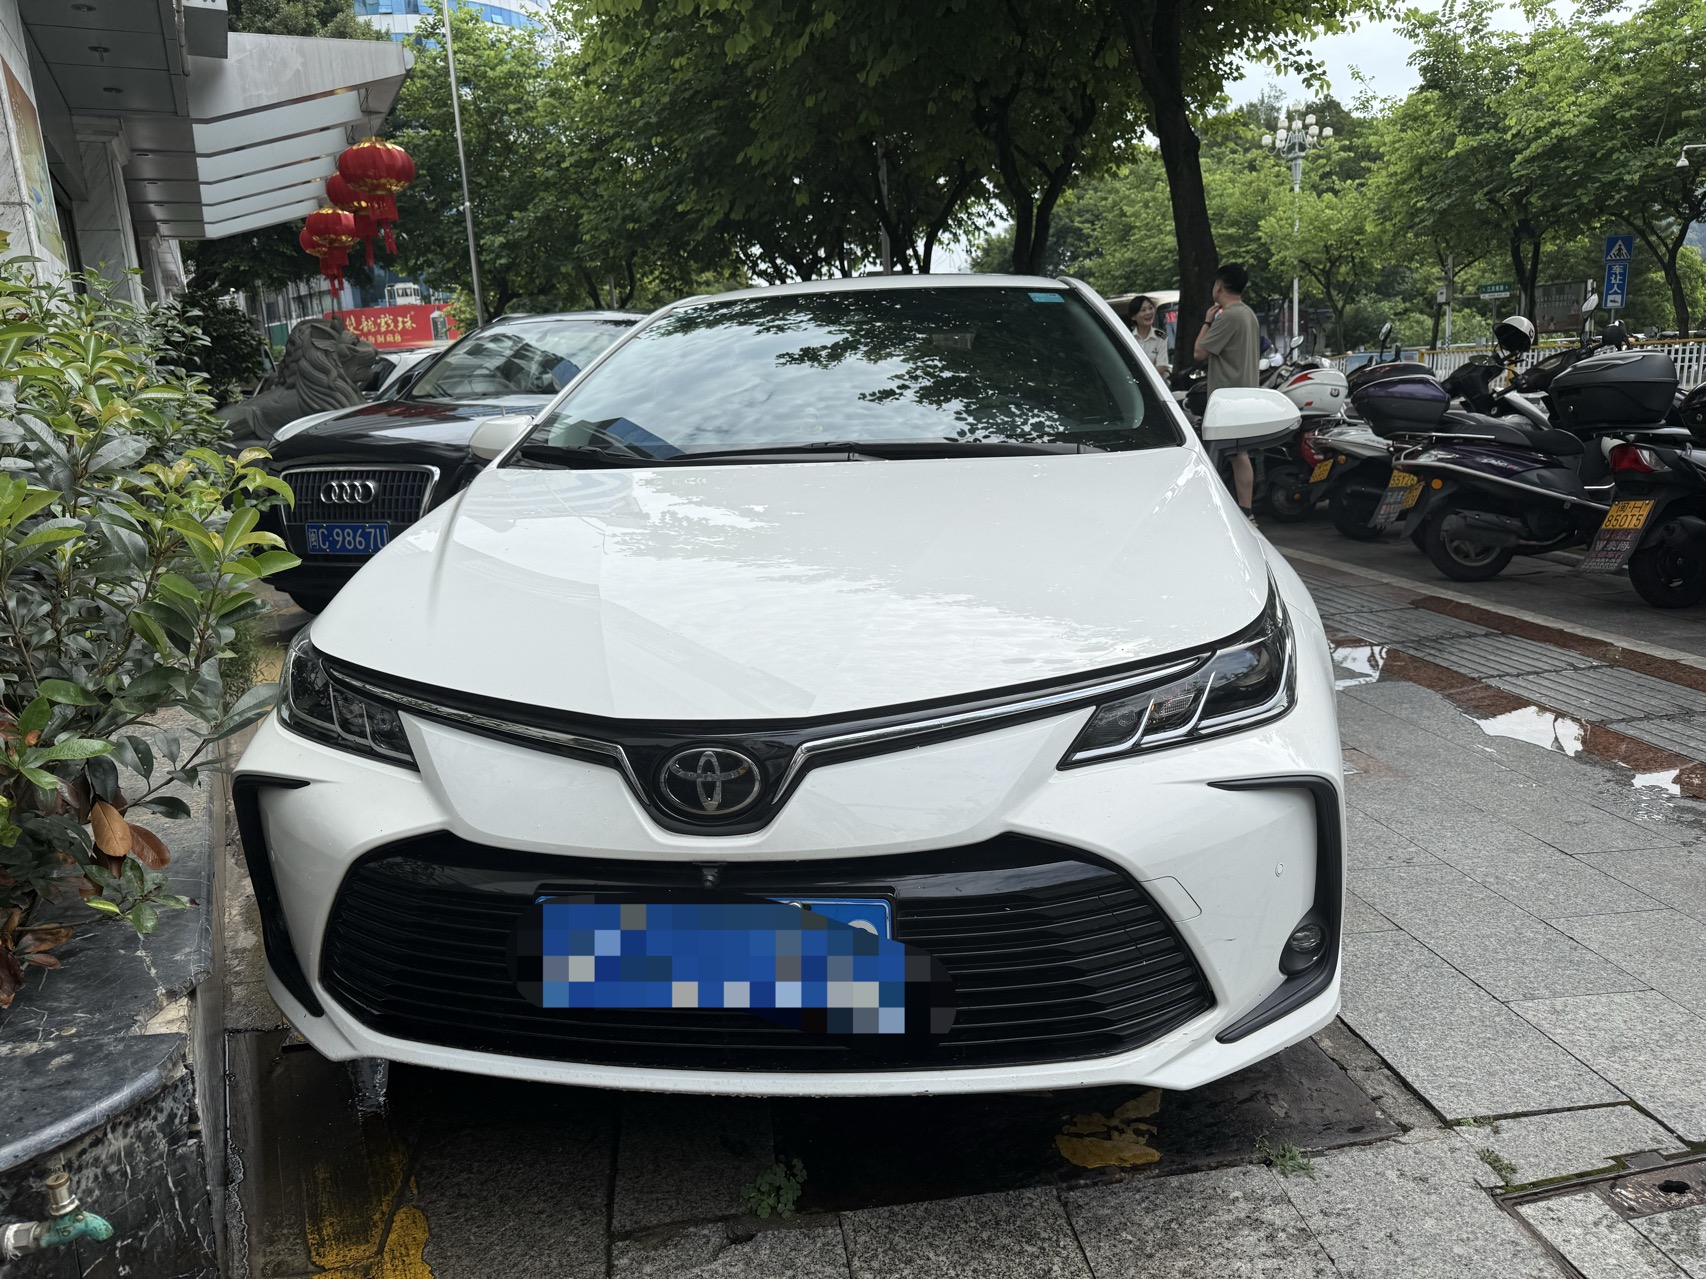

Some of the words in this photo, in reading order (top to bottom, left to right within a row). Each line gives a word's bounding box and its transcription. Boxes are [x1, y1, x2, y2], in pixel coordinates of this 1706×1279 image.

[1609, 265, 1624, 293] 车让人
[1604, 514, 1643, 528] 850T5
